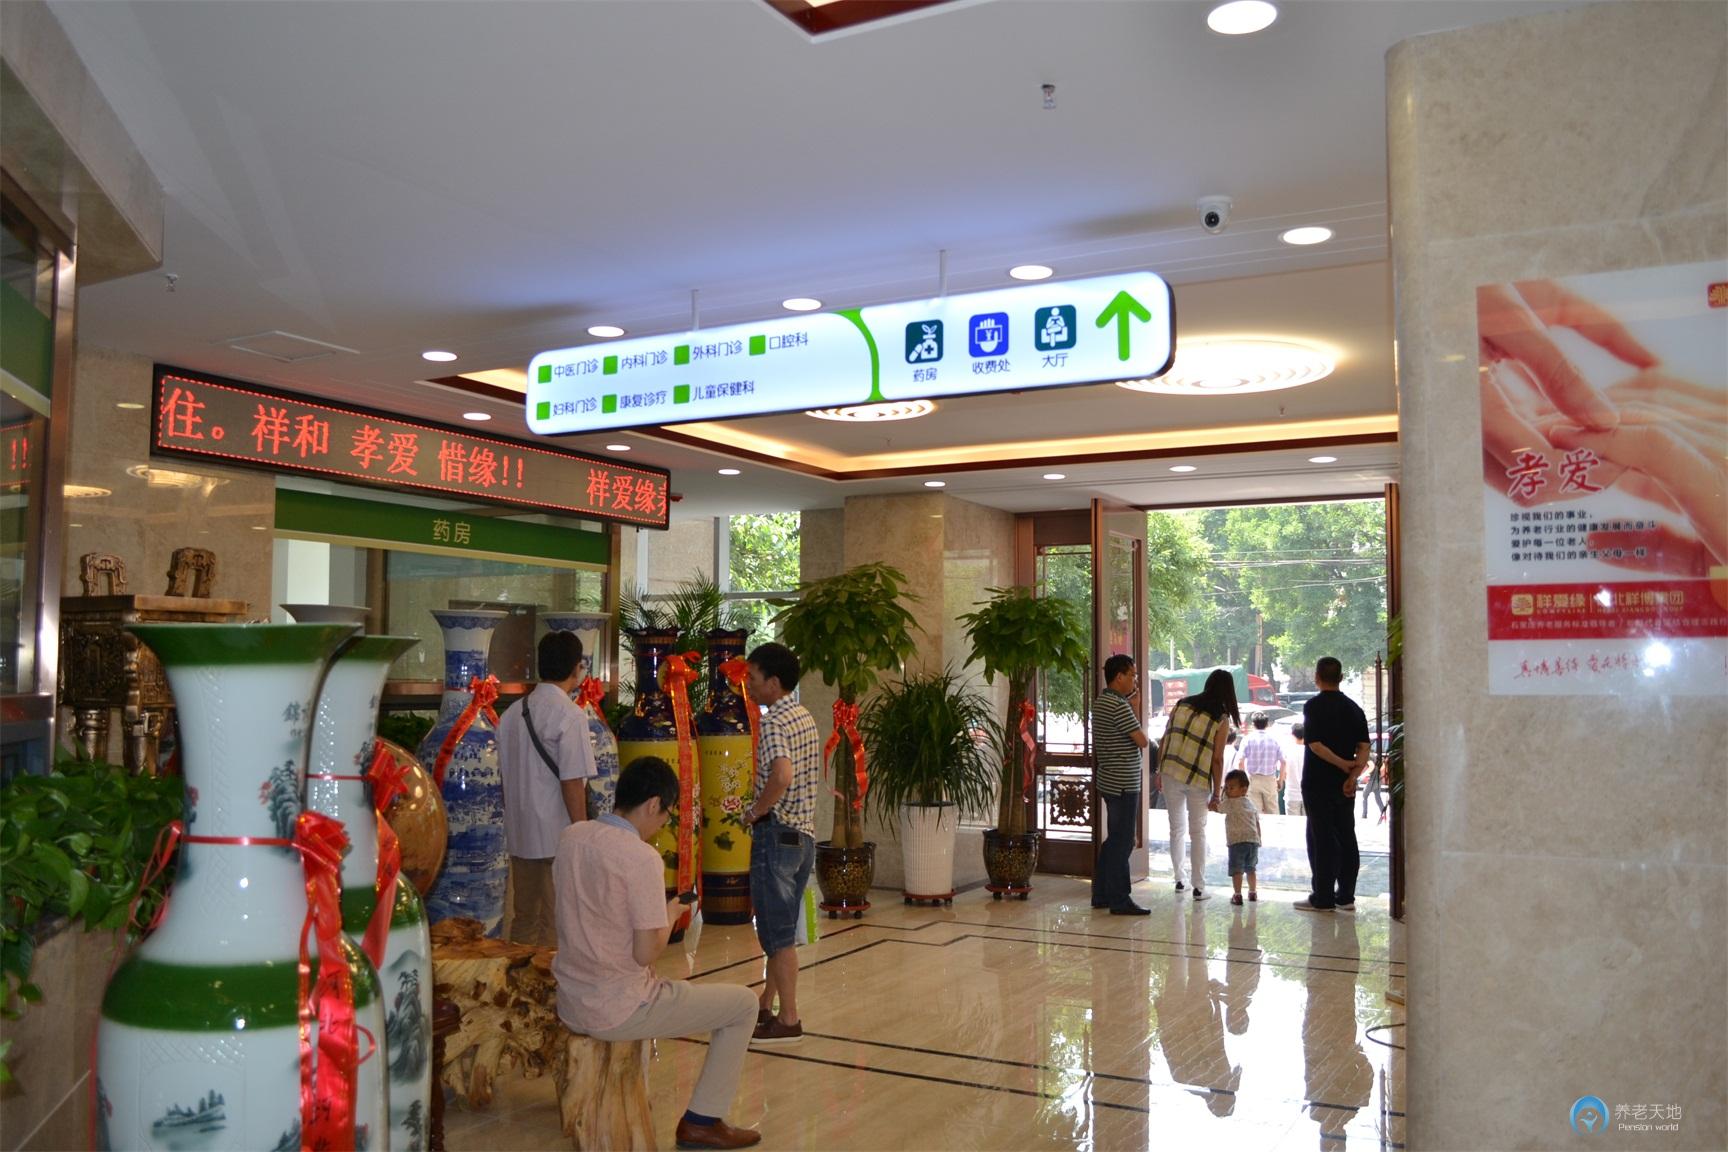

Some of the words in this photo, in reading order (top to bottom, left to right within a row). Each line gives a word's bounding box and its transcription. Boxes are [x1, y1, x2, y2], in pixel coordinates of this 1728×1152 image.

[553, 358, 599, 378] 中医门诊
[620, 350, 668, 370] 内科门诊
[692, 340, 743, 361] 外科门诊
[769, 332, 809, 351] 口腔科
[972, 358, 1011, 375] 收费处
[1042, 352, 1069, 368] 大厅
[913, 367, 938, 383] 药房
[552, 397, 598, 416] 妇科门诊
[619, 390, 667, 410] 康复诊疗
[692, 380, 754, 402] 儿童保健科
[162, 387, 225, 441] 住。
[251, 404, 329, 459] 祥和
[350, 424, 420, 477] 孝爱
[1506, 449, 1602, 498] 孝爱
[433, 518, 471, 544] 药房
